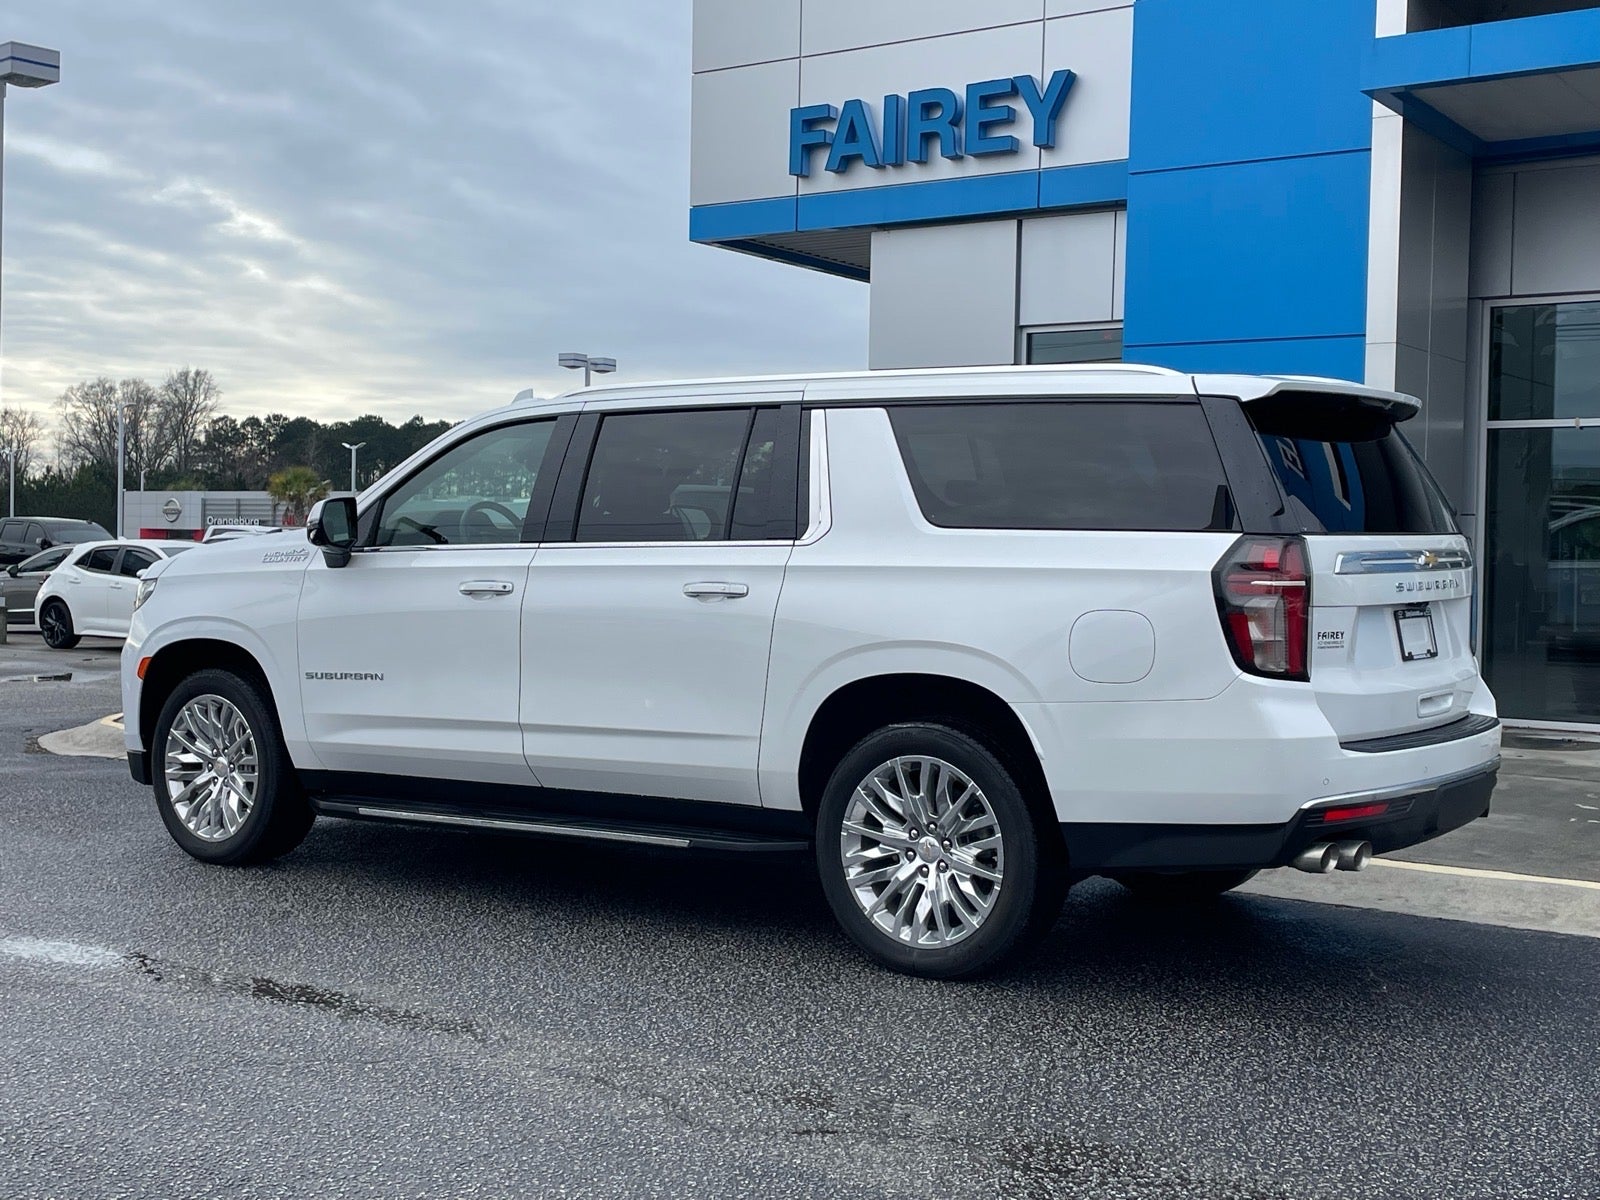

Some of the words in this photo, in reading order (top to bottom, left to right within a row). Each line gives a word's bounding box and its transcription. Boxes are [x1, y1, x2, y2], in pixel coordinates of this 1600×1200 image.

[789, 69, 1077, 177] FAIREY
[206, 516, 260, 526] Orangeburg
[1317, 631, 1345, 640] FAIREY
[305, 672, 384, 681] SUBURBAN
